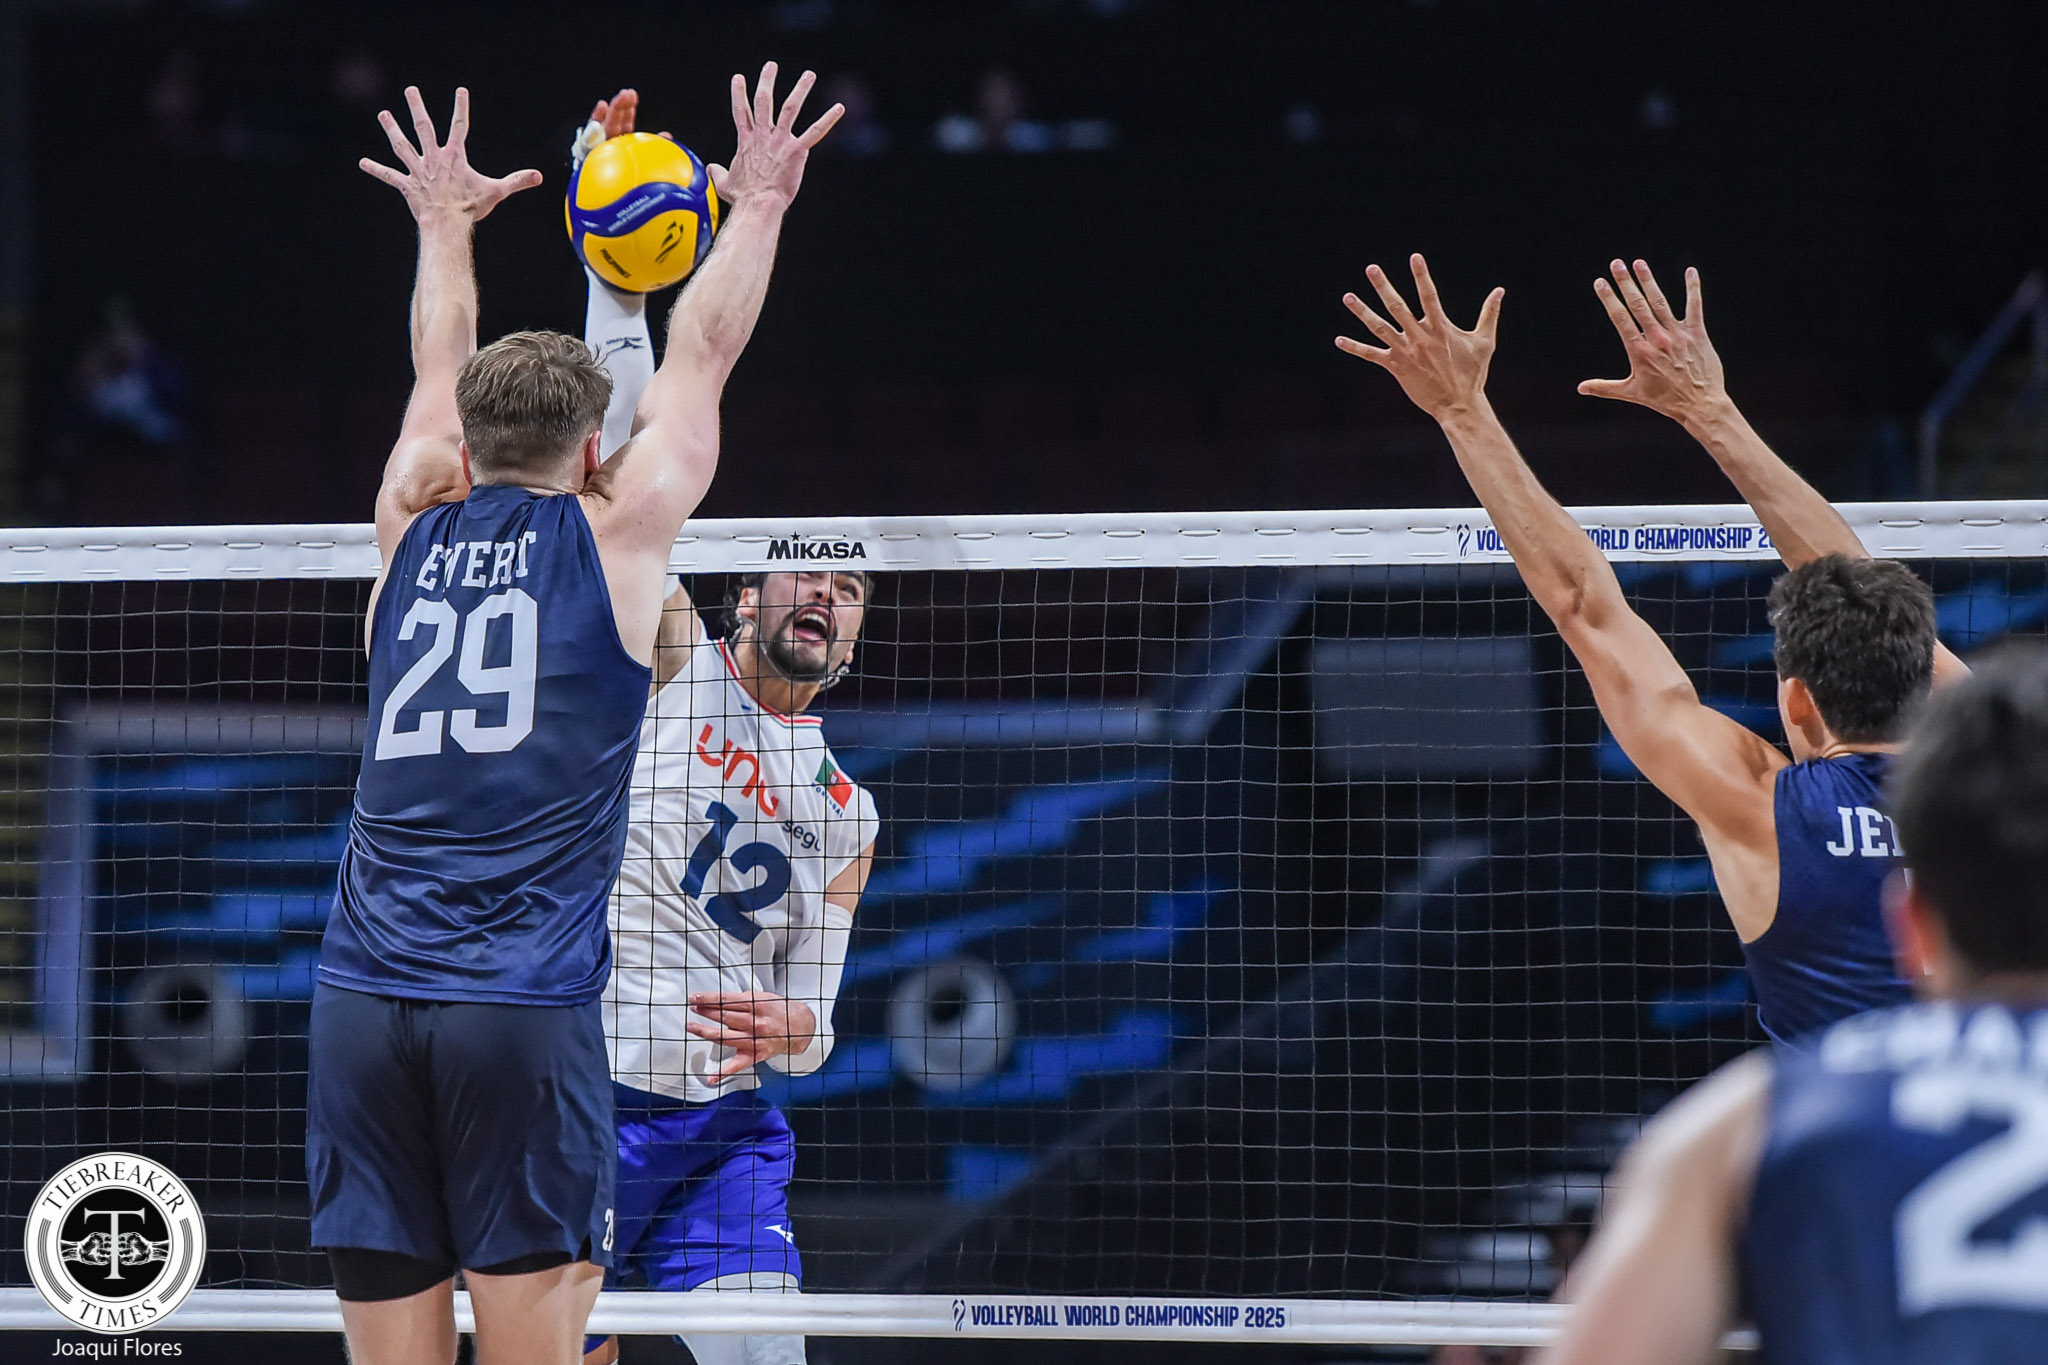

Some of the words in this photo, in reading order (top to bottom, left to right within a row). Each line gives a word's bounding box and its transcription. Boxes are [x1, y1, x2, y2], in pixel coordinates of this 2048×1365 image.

[766, 539, 867, 560] MIKASA
[1586, 529, 1630, 551] ORLD
[1634, 527, 1753, 550] CHAMPIONSHIP
[415, 531, 537, 592] EVERT
[375, 588, 538, 762] 29
[679, 800, 793, 945] 12
[971, 1305, 1058, 1327] VOLLEYBALL
[1064, 1305, 1120, 1327] WORLD
[1125, 1305, 1239, 1327] CHAMPIONSHIP
[1244, 1306, 1286, 1328] 2025
